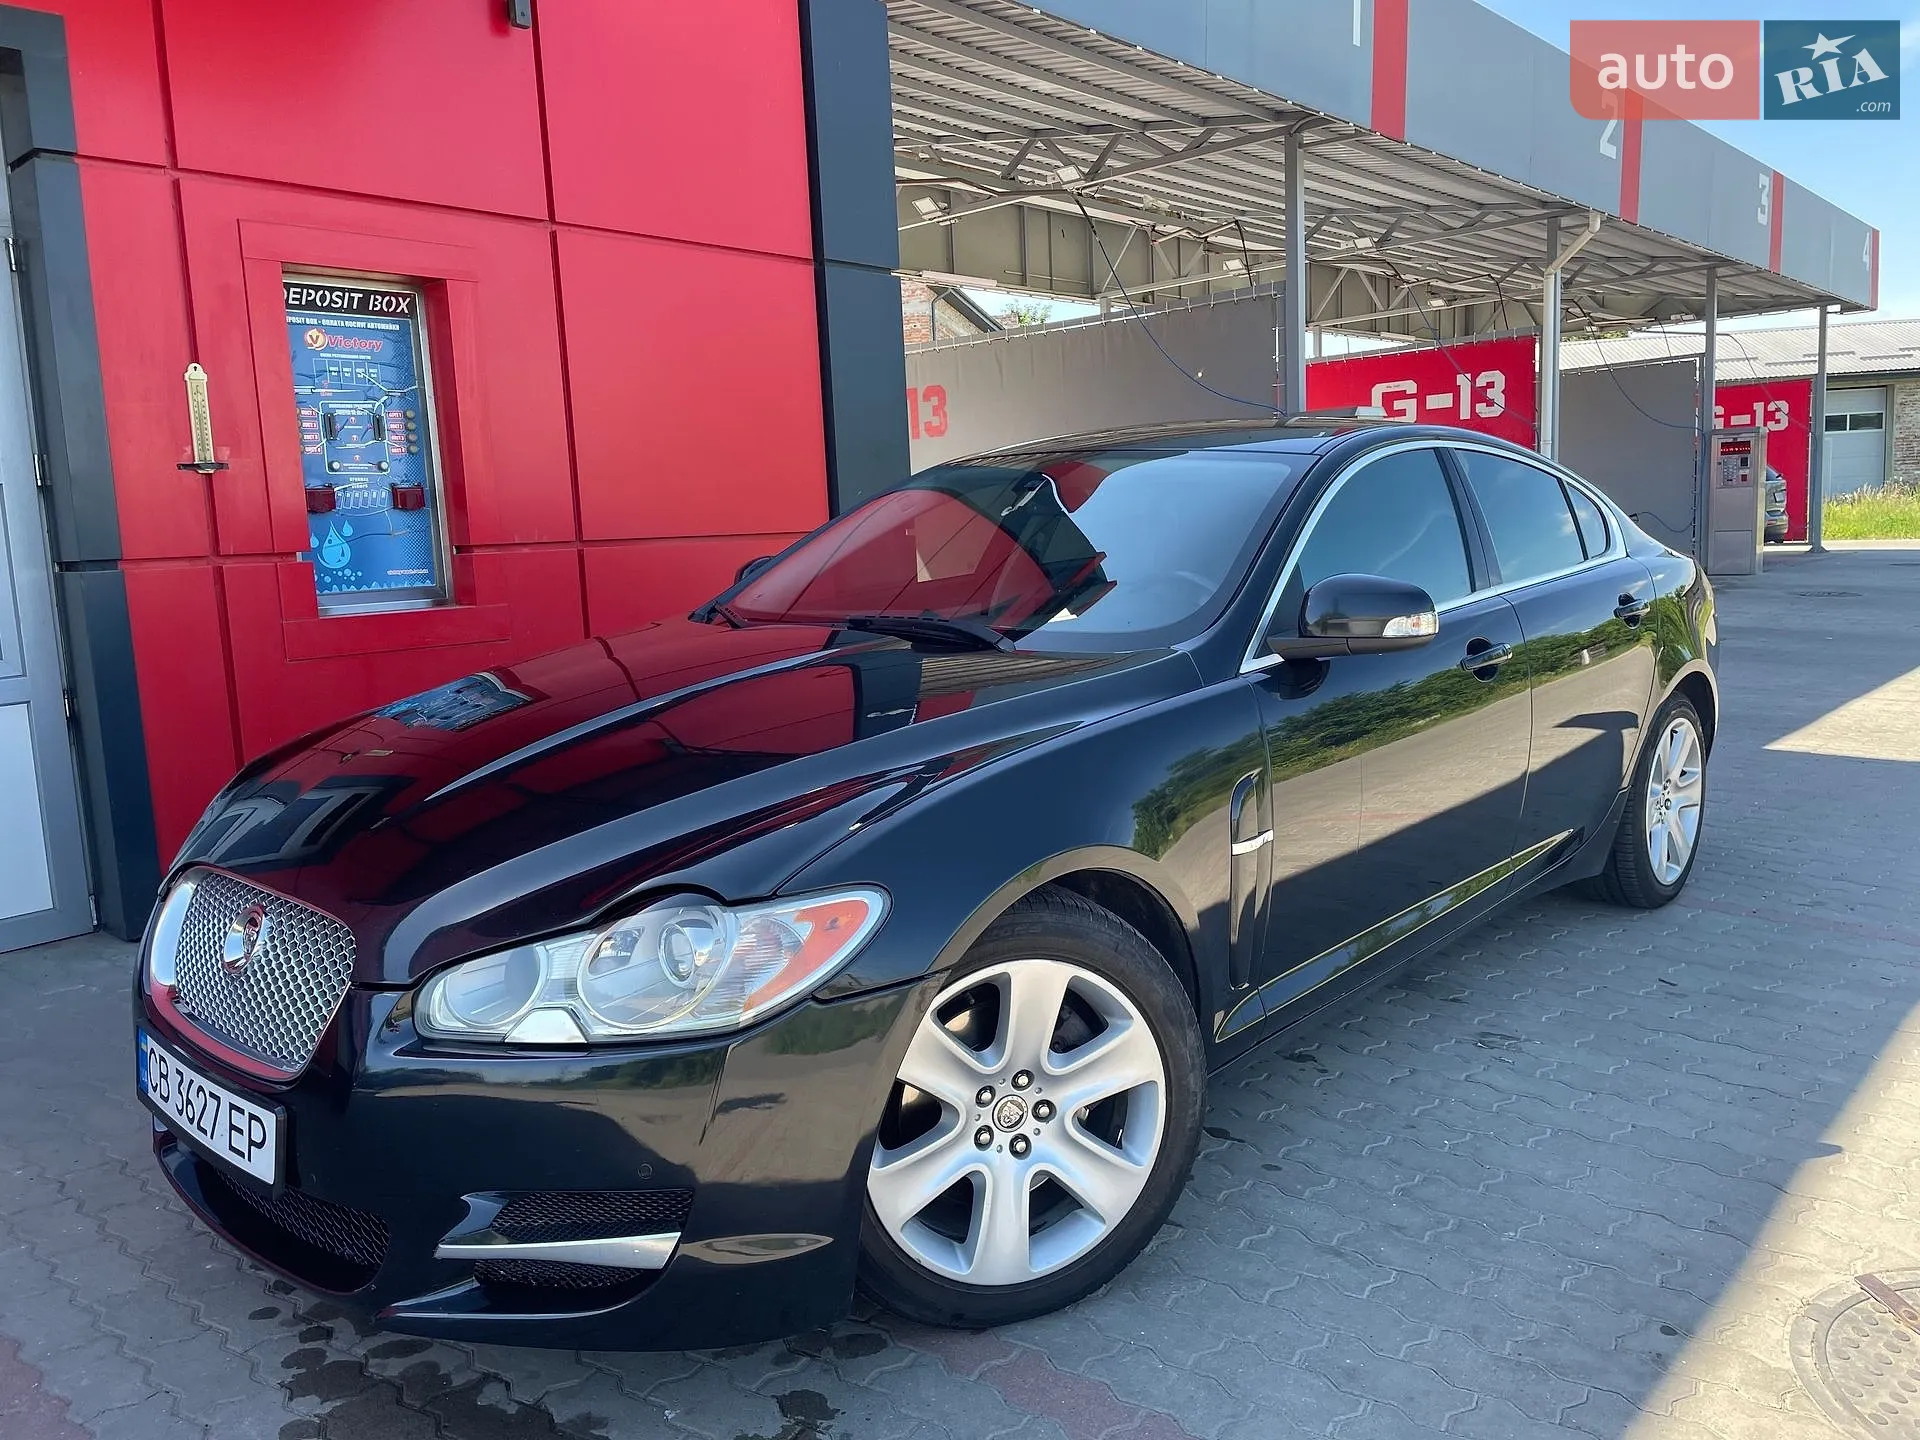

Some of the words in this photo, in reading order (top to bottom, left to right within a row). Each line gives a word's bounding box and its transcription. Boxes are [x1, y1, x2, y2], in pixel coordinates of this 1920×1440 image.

[1600, 88, 1618, 160] 2
[1758, 173, 1770, 226] 3
[1863, 232, 1870, 272] 4
[368, 294, 411, 314] BOX
[327, 334, 383, 352] Victory
[1371, 370, 1506, 423] G-13
[149, 1047, 170, 1104] CB
[174, 1066, 222, 1141] 3627
[228, 1101, 267, 1163] EP
